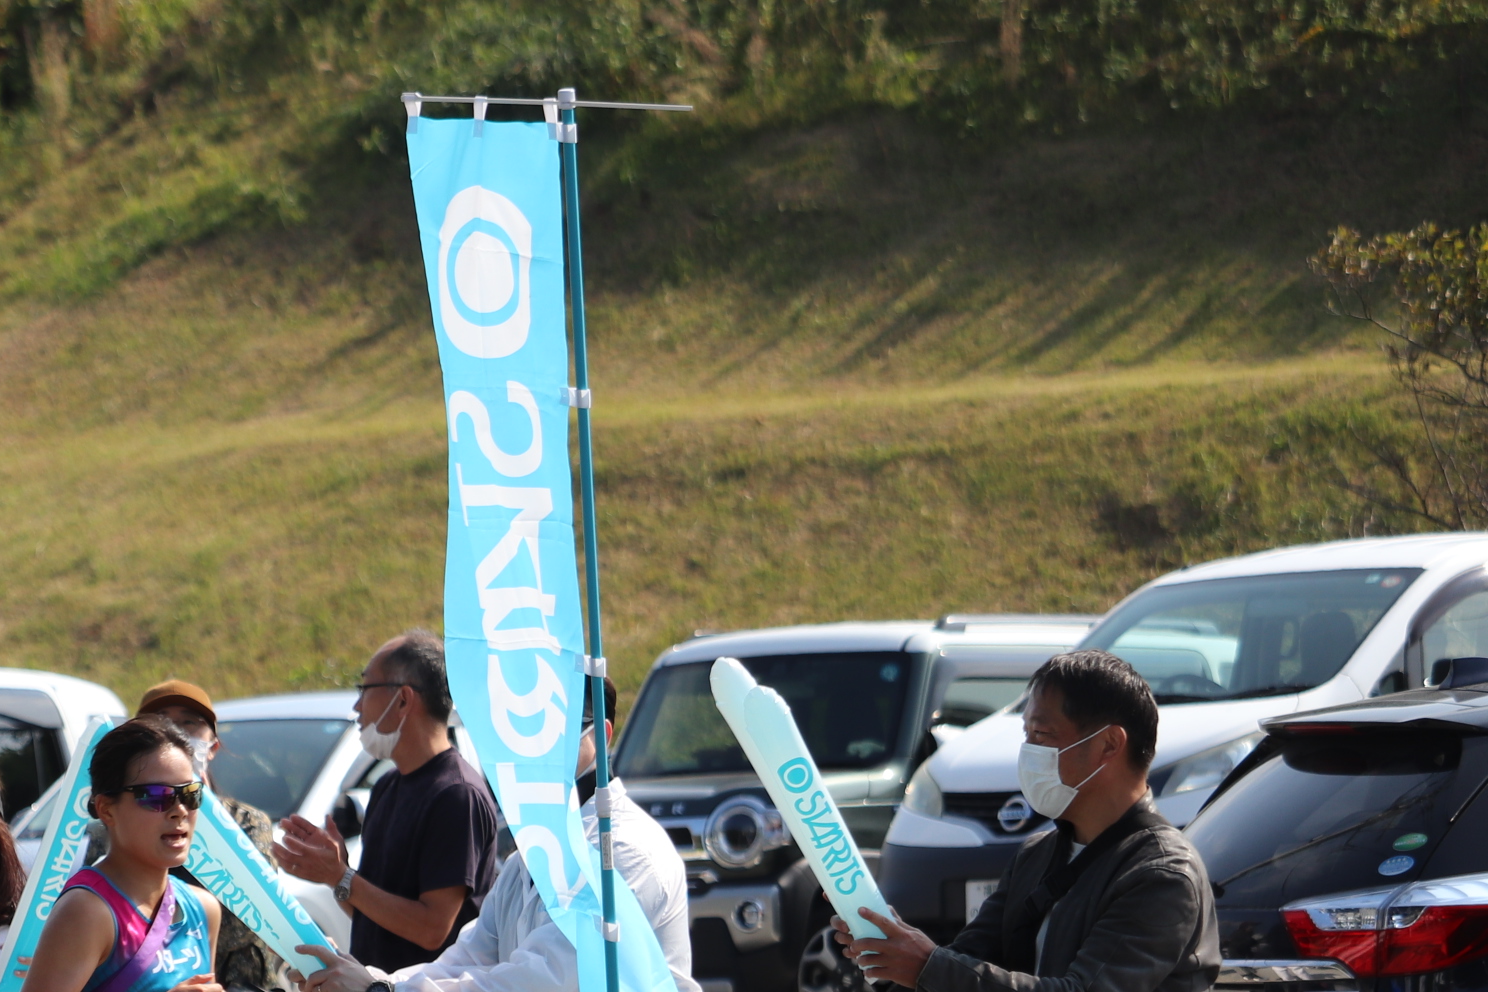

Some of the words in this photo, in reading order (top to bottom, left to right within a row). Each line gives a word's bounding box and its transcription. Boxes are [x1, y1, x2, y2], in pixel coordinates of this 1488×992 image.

[794, 790, 865, 896] STARTS
[152, 945, 202, 974] スターツ
